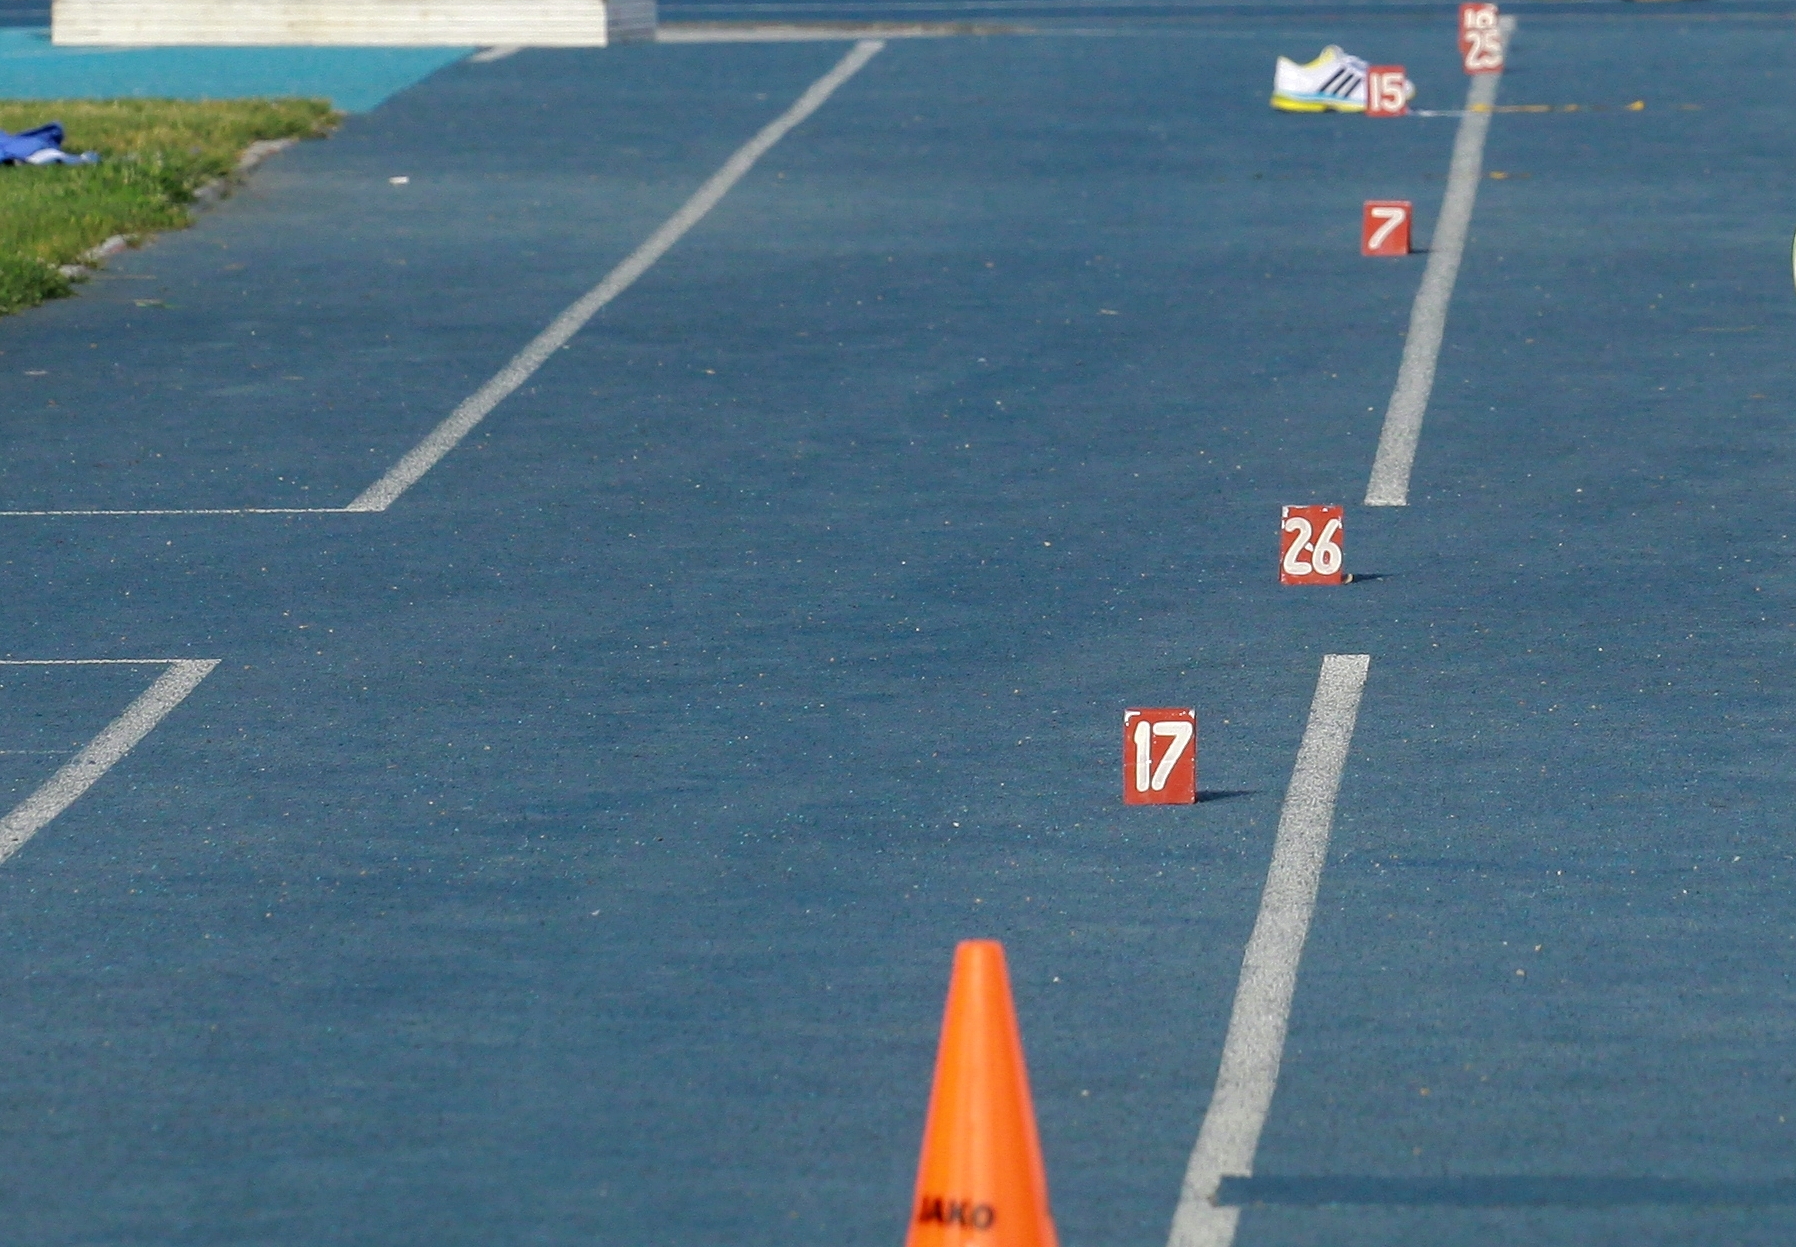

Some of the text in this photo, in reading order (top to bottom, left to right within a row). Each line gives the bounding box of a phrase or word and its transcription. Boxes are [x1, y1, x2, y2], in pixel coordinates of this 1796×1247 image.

[1465, 30, 1503, 69] 25
[1369, 71, 1404, 111] 15
[1367, 206, 1406, 250] 7
[1283, 516, 1344, 576] 26
[1132, 720, 1194, 793] 17
